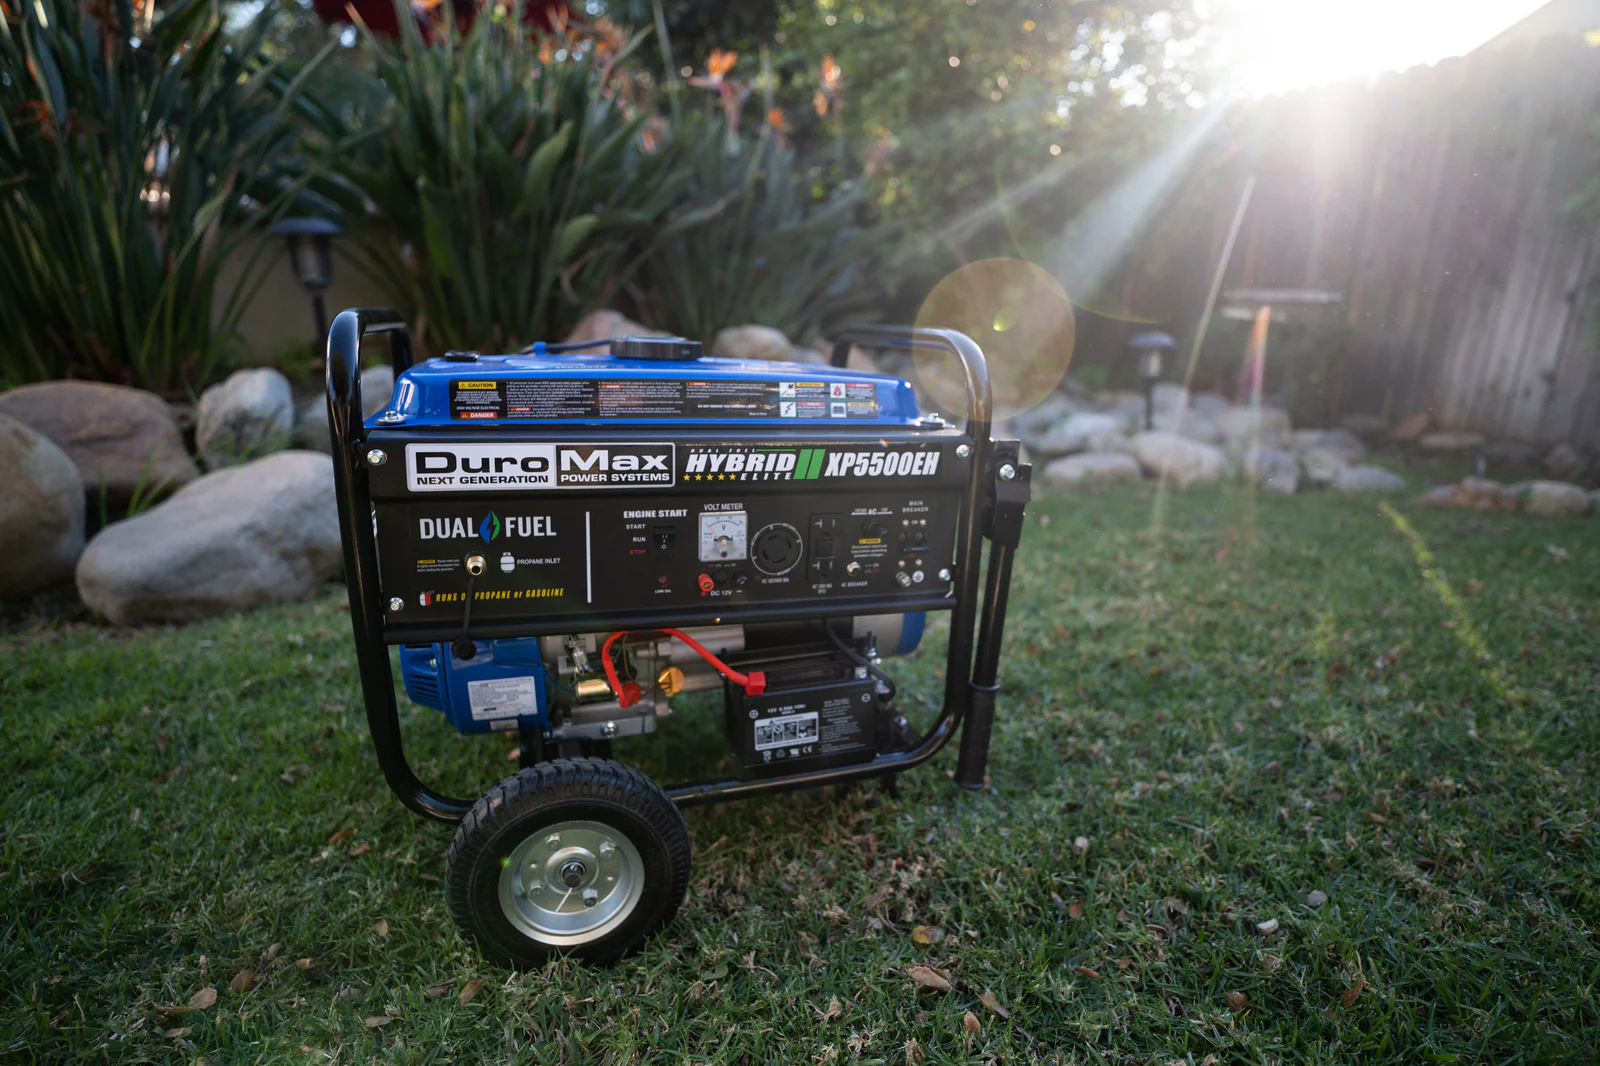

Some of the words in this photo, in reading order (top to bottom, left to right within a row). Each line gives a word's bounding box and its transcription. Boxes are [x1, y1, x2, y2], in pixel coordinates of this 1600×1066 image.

[416, 451, 549, 474] Duro
[560, 450, 669, 471] Max
[685, 453, 797, 473] HYBRID
[824, 451, 941, 477] XP5500EH
[417, 476, 457, 485] NEXT
[459, 475, 549, 485] GENERATION
[560, 474, 608, 483] POWER
[611, 472, 670, 482] SYSTEMS
[740, 472, 793, 481] ELITE
[704, 503, 720, 511] VOLT
[623, 510, 657, 519] ENGINE
[658, 509, 688, 518] START
[419, 517, 479, 540] DUAL
[505, 515, 557, 538] FUEL
[436, 593, 457, 602] RUNS
[475, 590, 511, 601] PROPANE
[513, 590, 522, 598] or
[525, 588, 564, 598] GASOLINE
